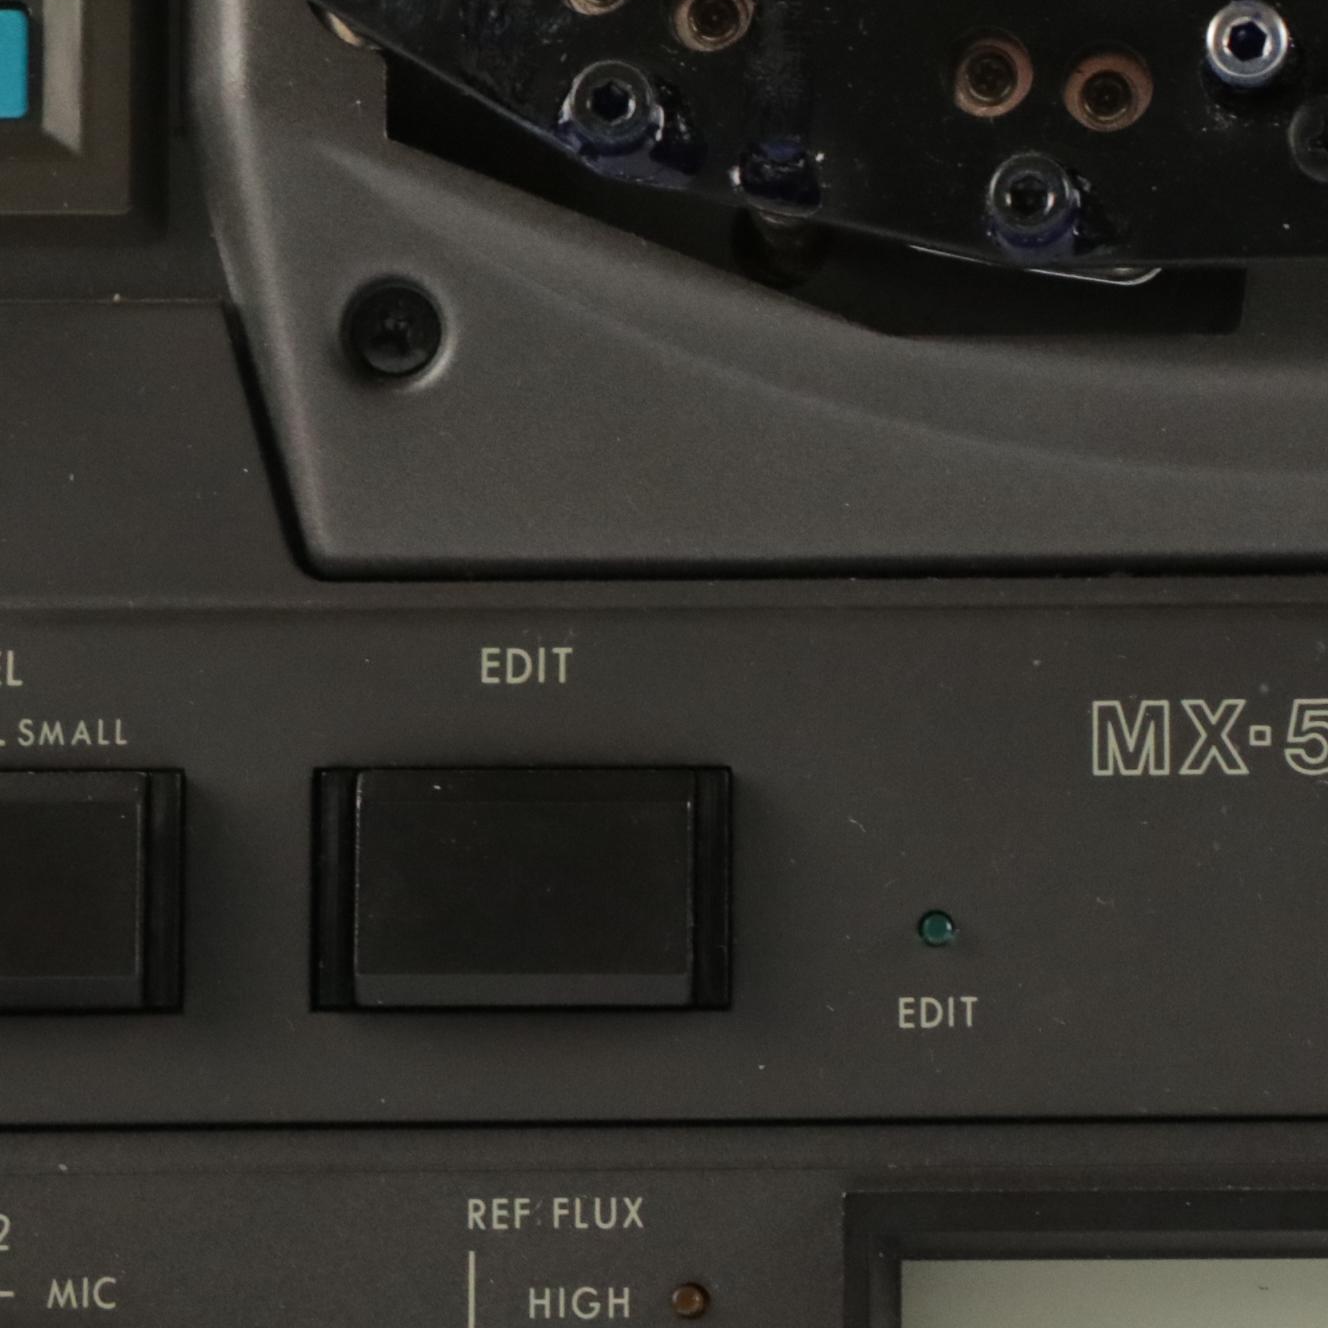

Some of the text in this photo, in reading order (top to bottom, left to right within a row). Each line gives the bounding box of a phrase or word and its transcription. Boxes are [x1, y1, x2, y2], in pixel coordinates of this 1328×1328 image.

[0, 649, 24, 687] L
[480, 646, 573, 685] EDIT
[17, 718, 128, 747] SMALL
[898, 996, 978, 1029] EDIT
[467, 1196, 644, 1230] REF FLUX
[46, 1276, 117, 1310] MIC
[528, 1286, 630, 1320] HIGH
